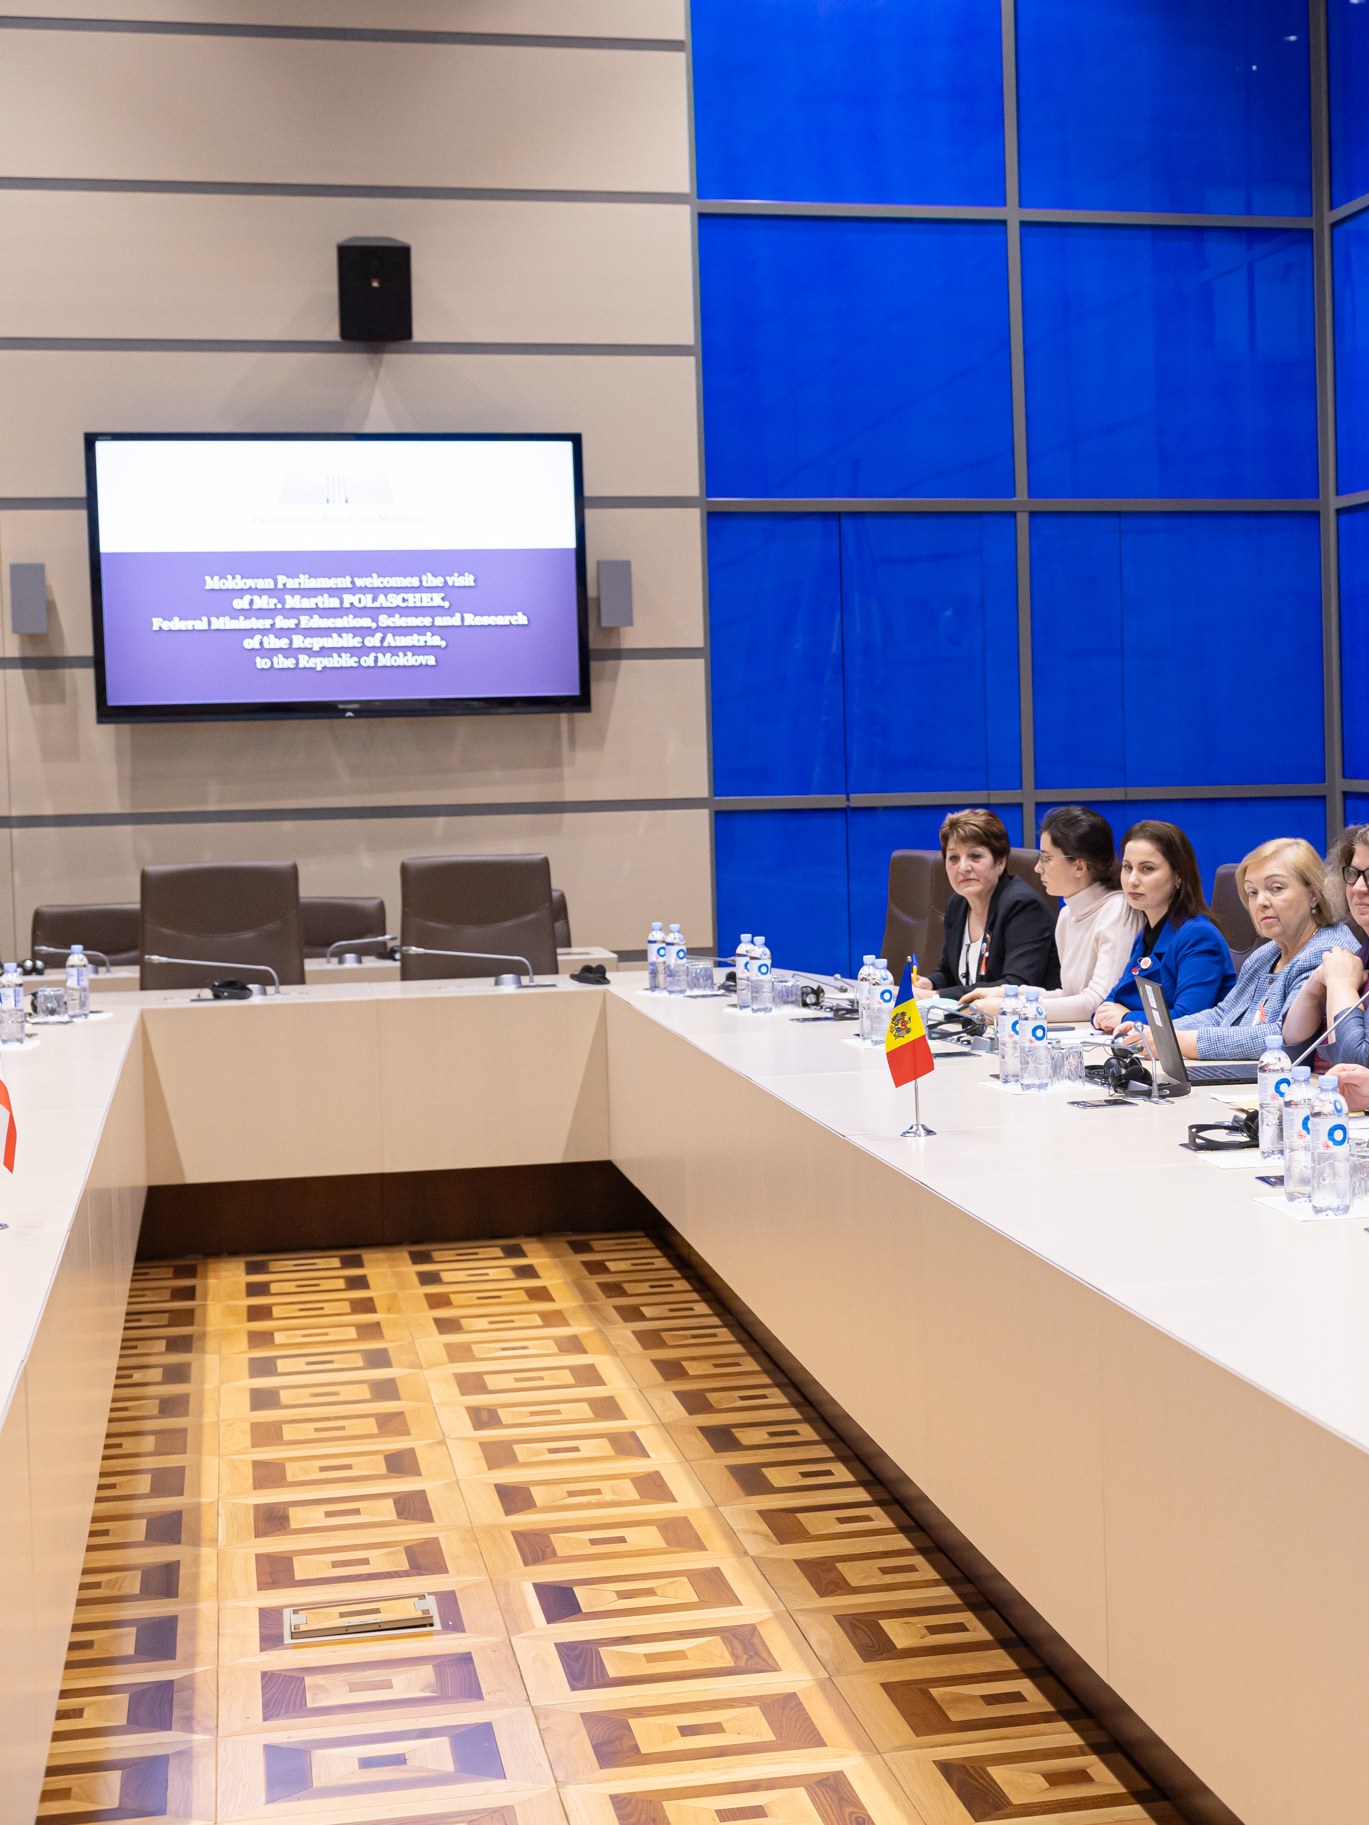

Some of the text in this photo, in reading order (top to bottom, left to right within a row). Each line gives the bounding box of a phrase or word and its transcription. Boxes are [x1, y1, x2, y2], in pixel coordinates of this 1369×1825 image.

[204, 572, 476, 590] Moldovan Parliament welcomes the visit
[232, 592, 451, 609] of Mr. Martin POLASCHEK,
[151, 611, 529, 631] Federal Minister for Education, Science and Research
[242, 631, 447, 651] of the Republic of Austria,
[255, 651, 437, 671] to the Republic of Moldova
